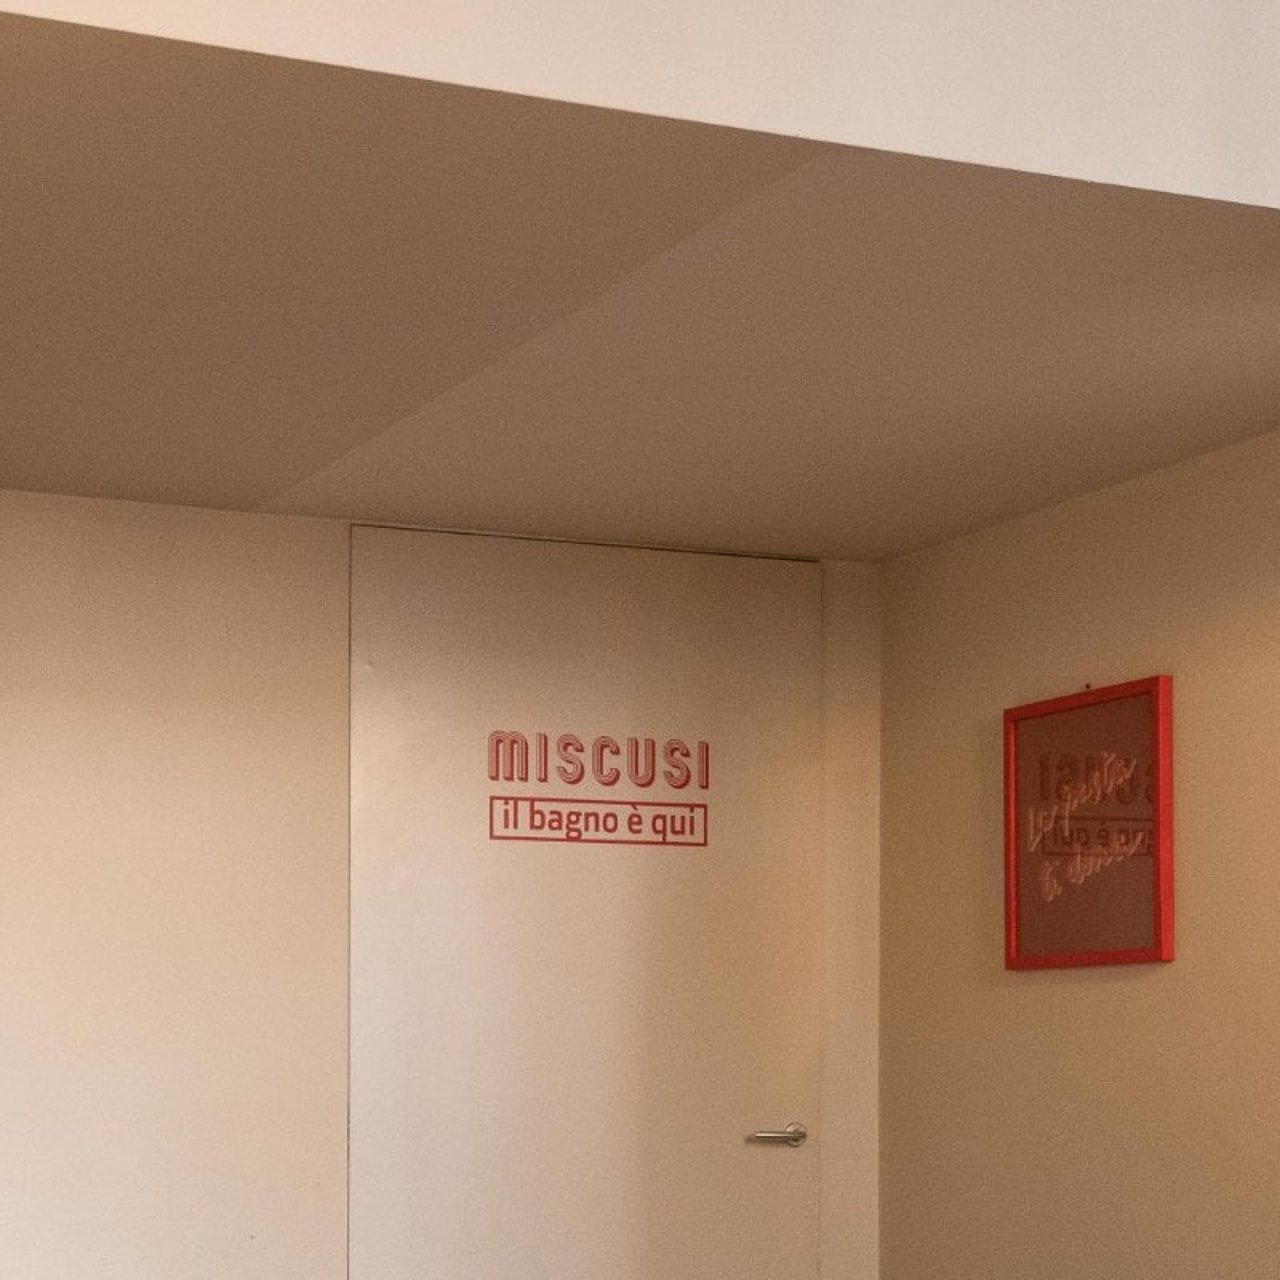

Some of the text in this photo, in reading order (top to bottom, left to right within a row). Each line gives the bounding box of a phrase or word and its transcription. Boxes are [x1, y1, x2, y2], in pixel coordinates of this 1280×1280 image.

[487, 730, 710, 790] MISCUSI
[502, 800, 696, 842] il bagno è qui
